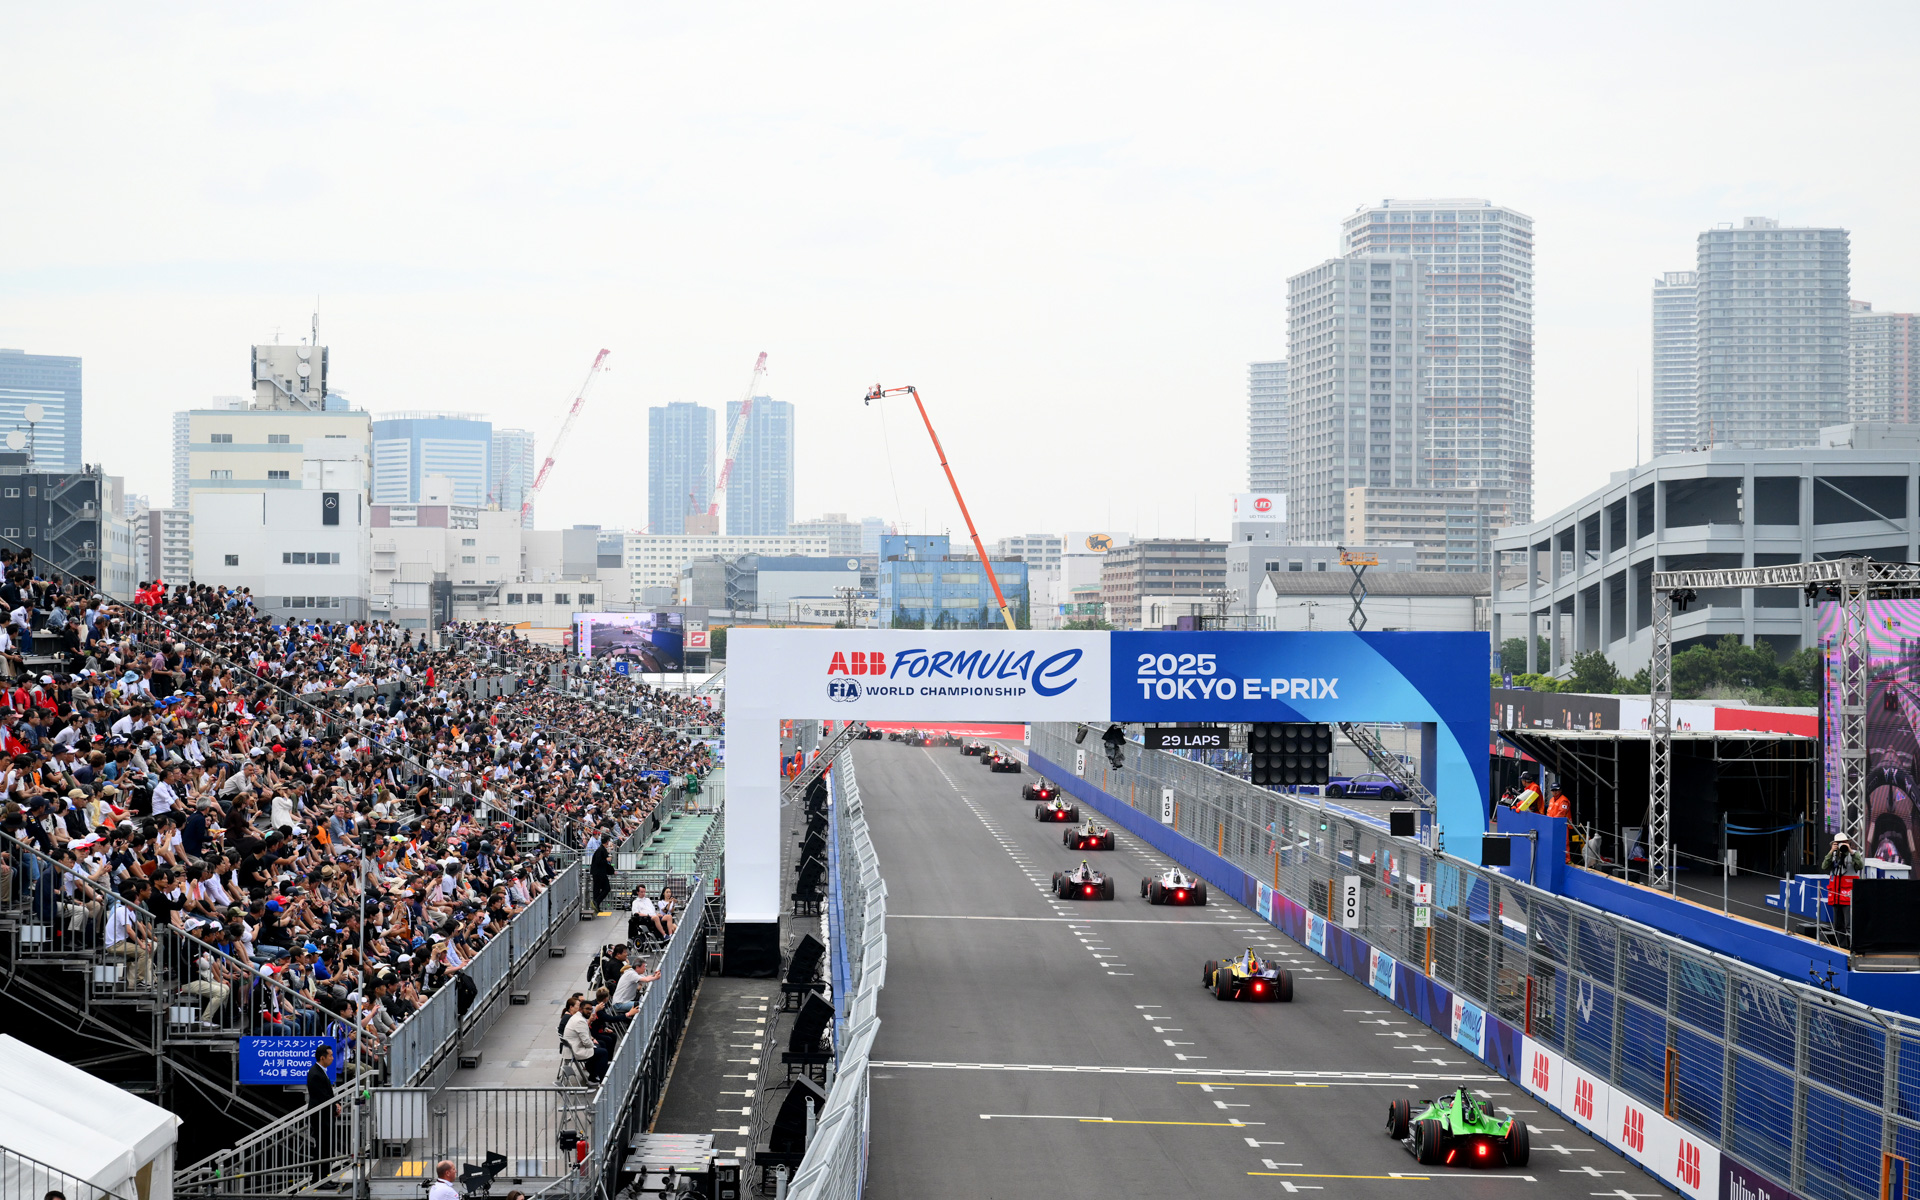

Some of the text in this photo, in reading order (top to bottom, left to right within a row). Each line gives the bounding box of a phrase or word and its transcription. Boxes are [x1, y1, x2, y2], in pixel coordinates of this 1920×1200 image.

[1255, 501, 1271, 509] UD
[827, 651, 887, 676] ABB
[890, 648, 1036, 681] FORMULA
[1137, 653, 1217, 676] 2025
[866, 686, 915, 696] WORLD
[920, 686, 1026, 697] CHAMPIONSHIP
[1137, 677, 1339, 700] TOKYO E-PRIX
[1161, 735, 1221, 746] 29 LAPS
[1346, 886, 1356, 919] 200
[257, 1049, 316, 1058] Grandstand 2
[263, 1059, 275, 1067] A-I
[286, 1059, 312, 1067] Rows
[259, 1069, 280, 1077] 1-40
[1531, 1050, 1549, 1092] ABB
[1573, 1076, 1593, 1121] ABB
[1622, 1105, 1644, 1153] ABB
[1676, 1137, 1700, 1190] ABB
